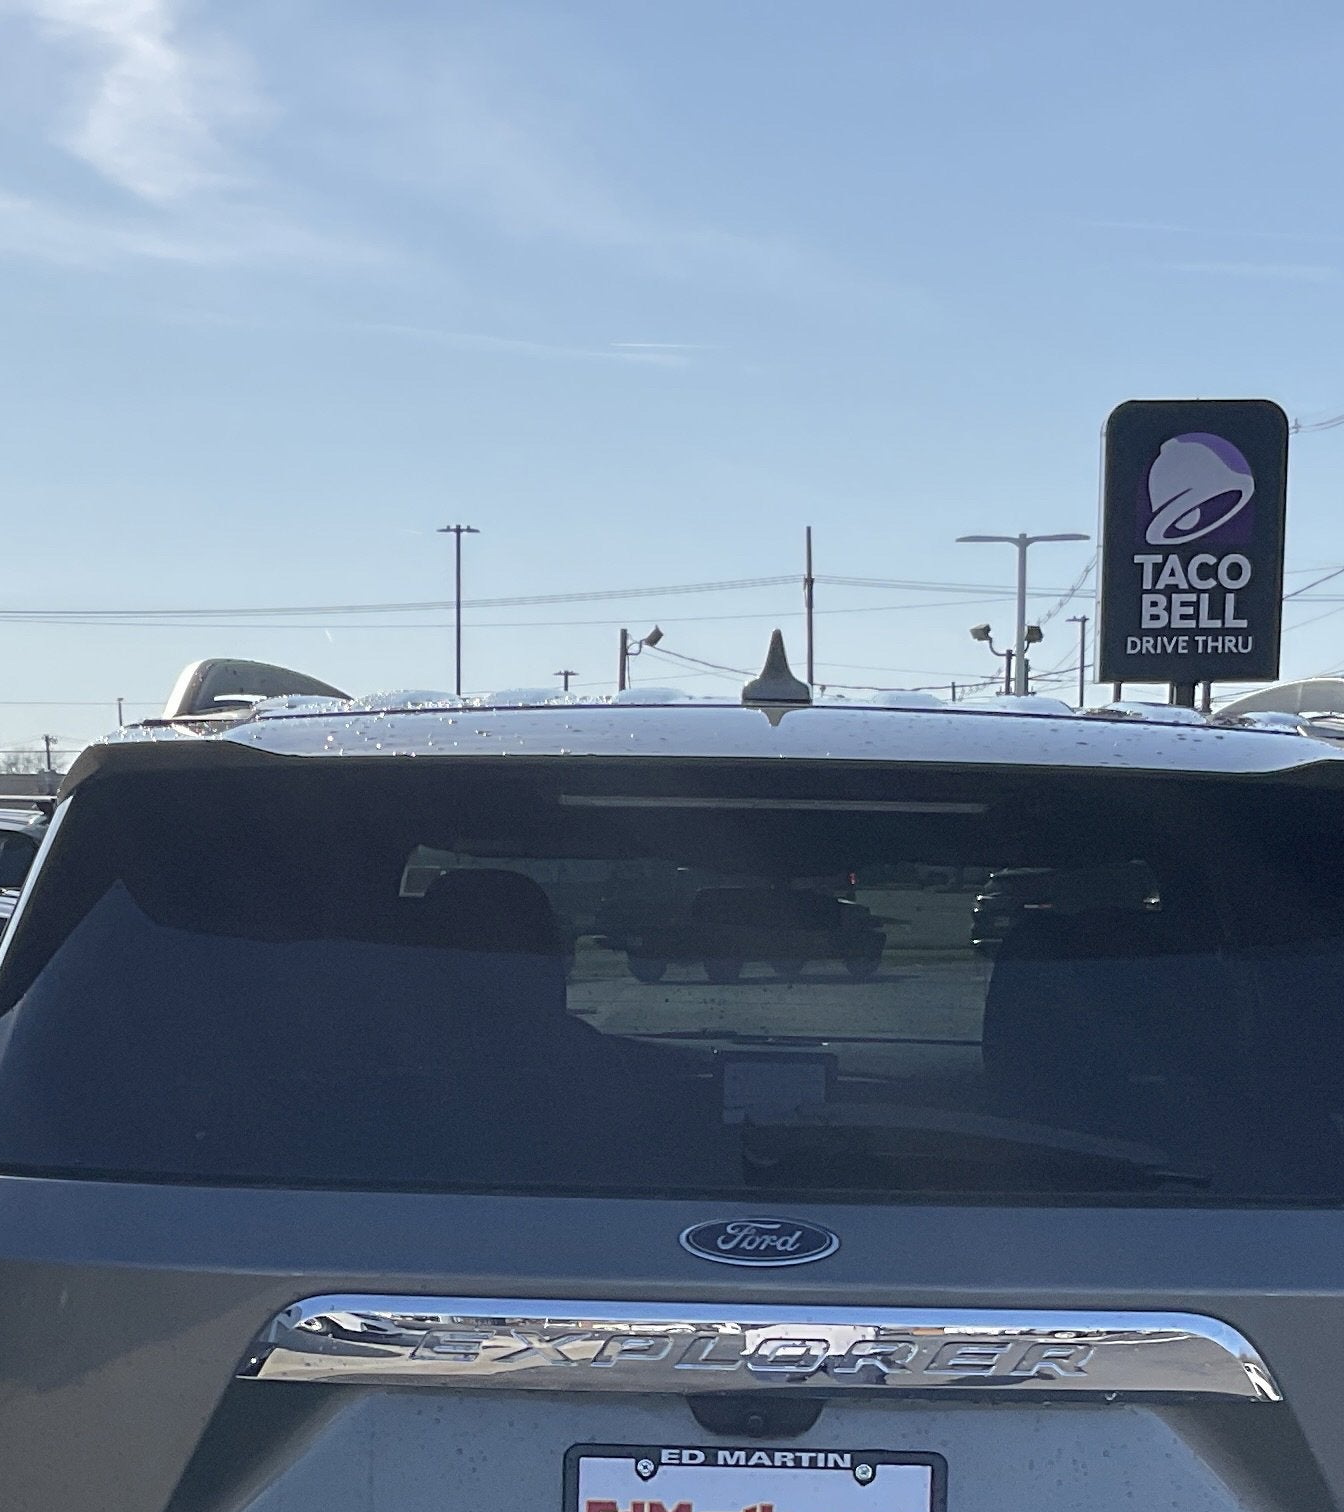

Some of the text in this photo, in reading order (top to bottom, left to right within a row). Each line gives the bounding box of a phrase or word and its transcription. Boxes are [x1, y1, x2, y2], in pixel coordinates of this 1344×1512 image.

[1133, 553, 1252, 590] TACO
[1141, 593, 1248, 629] BELL
[1126, 635, 1253, 655] DRIVE THRU
[716, 1222, 803, 1251] Ford
[408, 1328, 1096, 1377] EXPLORER
[660, 1448, 852, 1469] ED MARTIN
